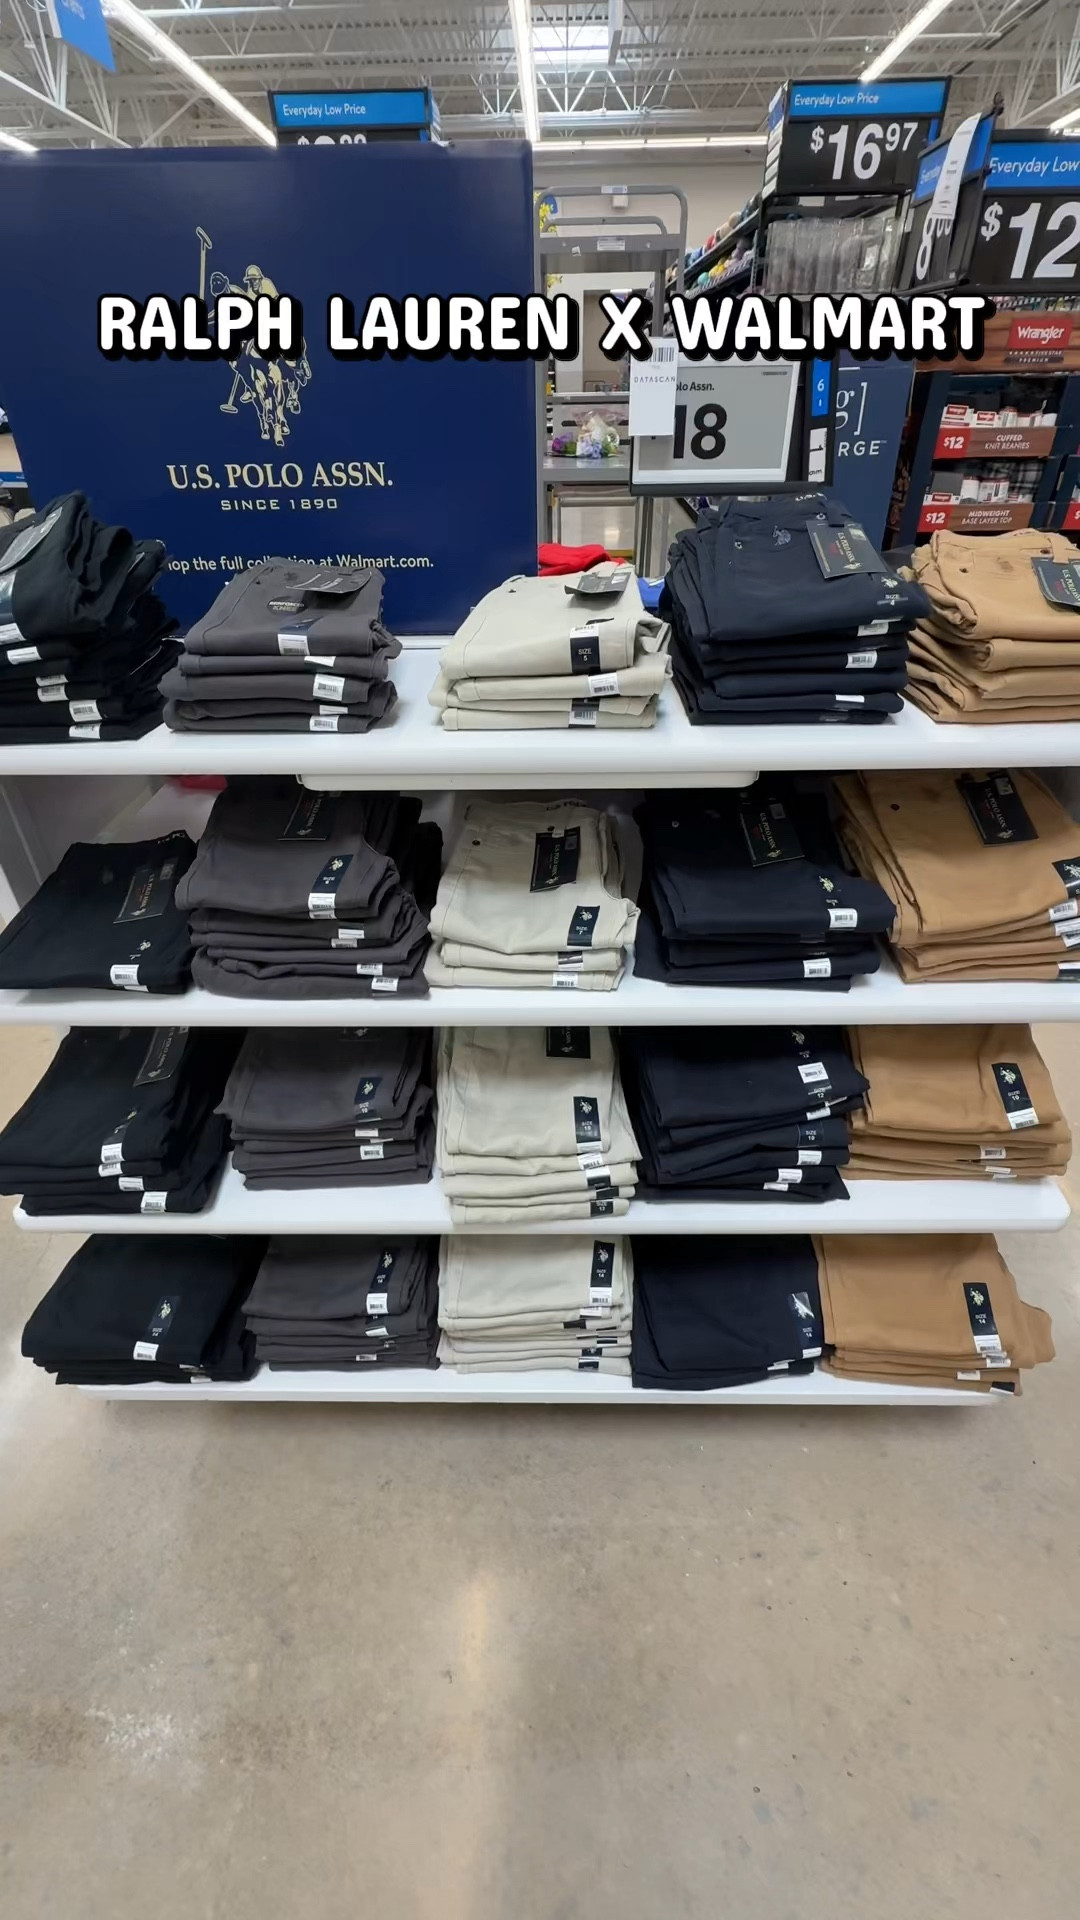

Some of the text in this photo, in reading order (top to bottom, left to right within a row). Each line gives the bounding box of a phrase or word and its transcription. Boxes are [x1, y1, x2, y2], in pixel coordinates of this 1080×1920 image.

[794, 92, 880, 107] Everyday Low Price
[283, 103, 366, 118] Everyday Low Price
[989, 156, 1080, 177] Everyday Low
[1017, 326, 1065, 344] Wrangler
[634, 375, 676, 383] DATASCAN
[689, 381, 715, 391] Assn.
[943, 436, 964, 449] $12
[996, 434, 1022, 442] CUFFED
[838, 440, 880, 456] RGE
[985, 442, 1030, 450] KNIT BEANIES
[166, 462, 394, 489] U.S. POLO ASSN.
[220, 498, 338, 511] SINCE 1890
[925, 512, 946, 524] $12
[961, 517, 978, 525] BASE
[979, 517, 999, 525] LAYER
[168, 560, 190, 575] op
[193, 557, 217, 571] the
[219, 556, 244, 571] full
[319, 556, 333, 568] at
[336, 554, 434, 569] Walmart.com.
